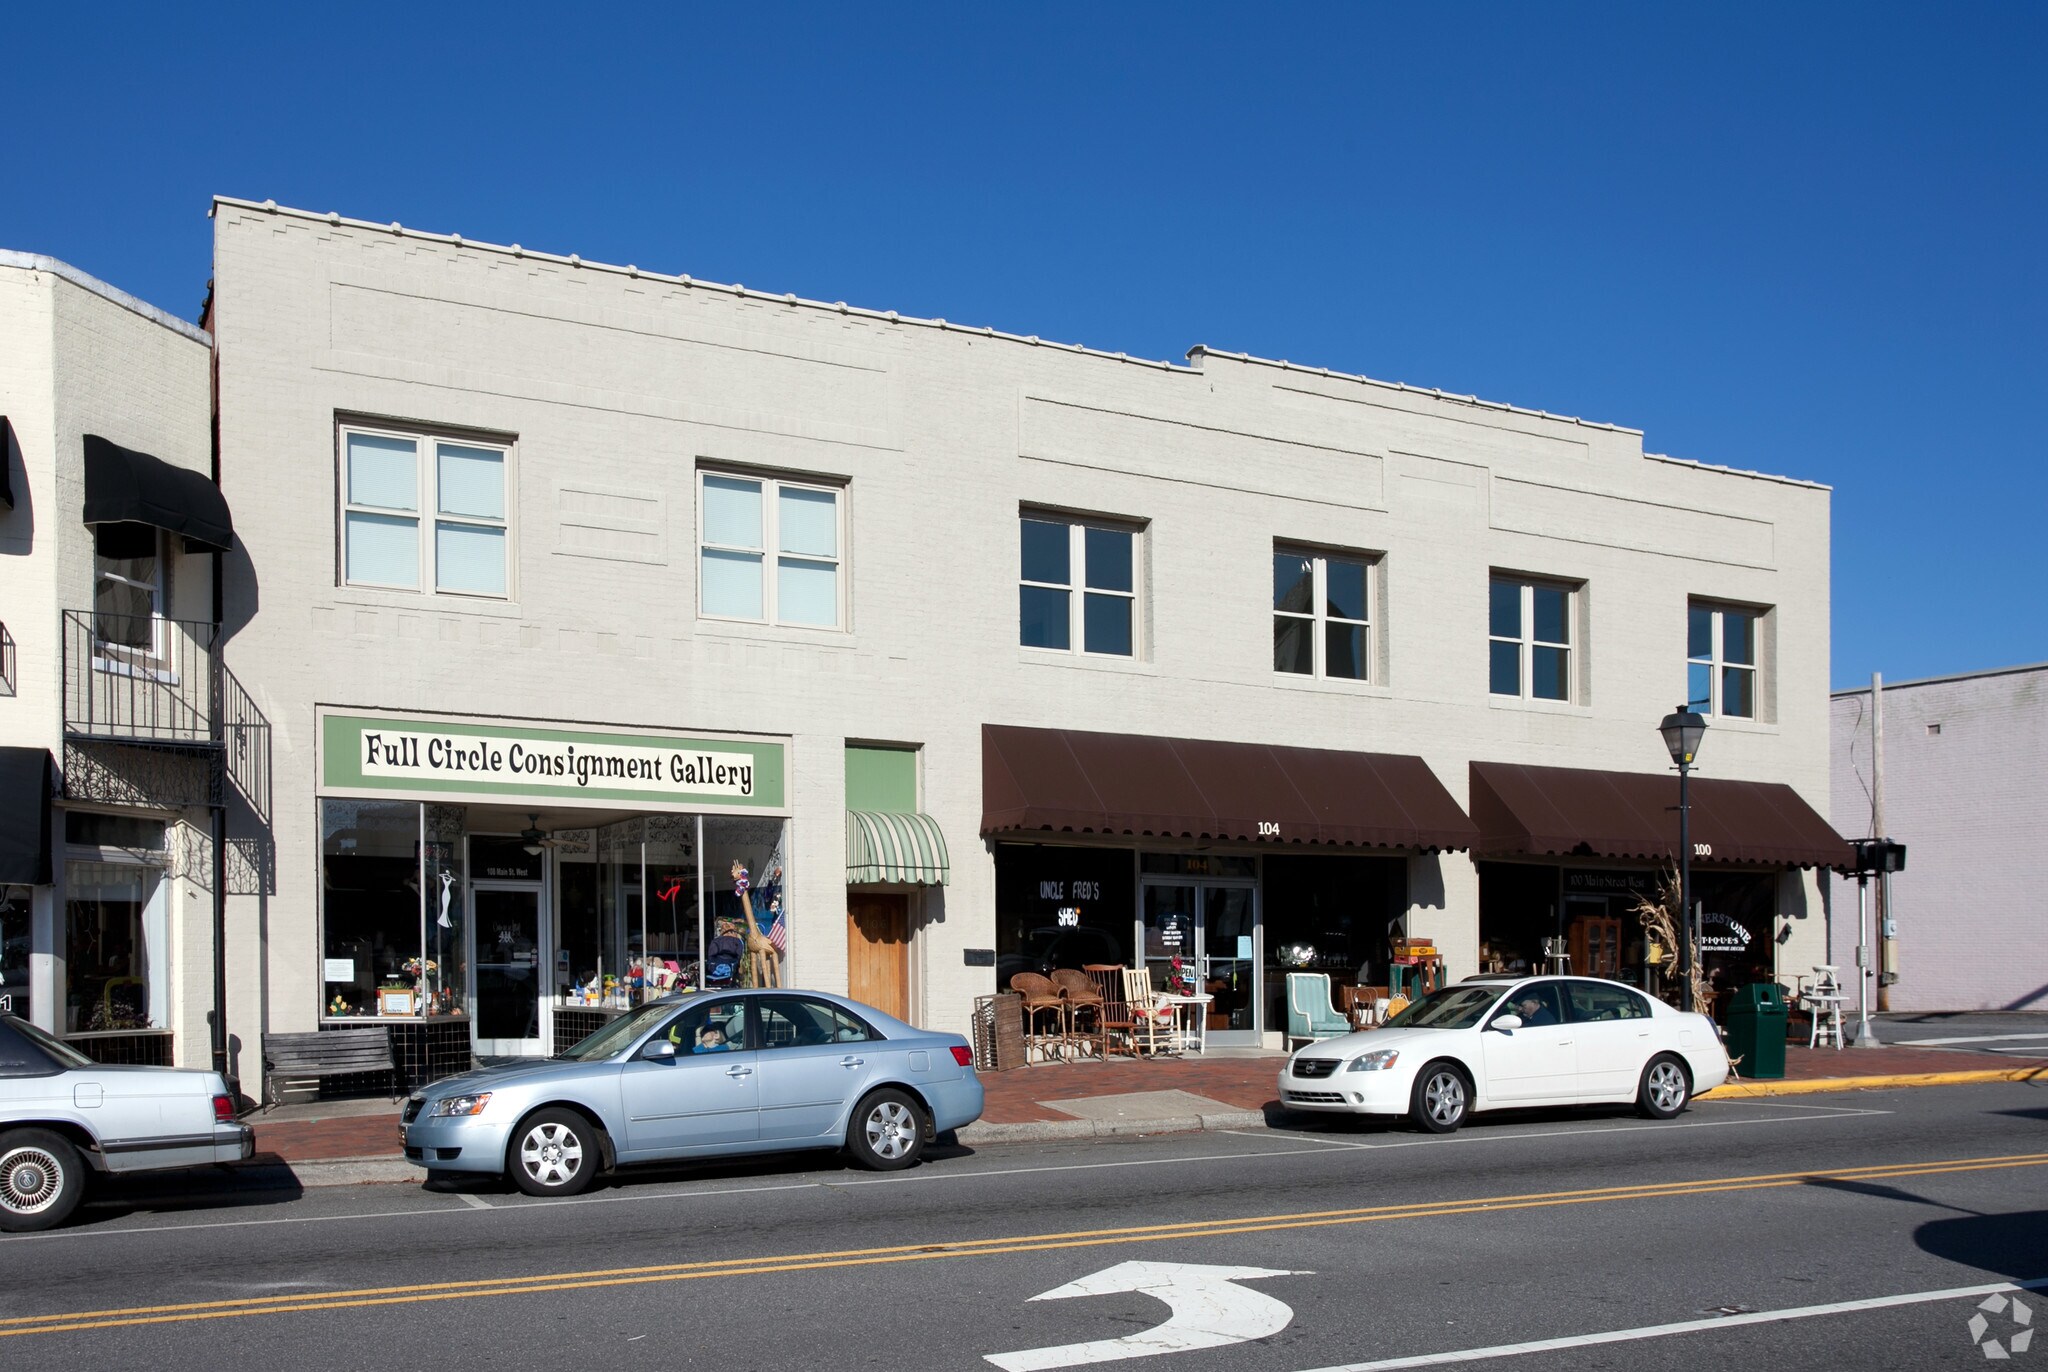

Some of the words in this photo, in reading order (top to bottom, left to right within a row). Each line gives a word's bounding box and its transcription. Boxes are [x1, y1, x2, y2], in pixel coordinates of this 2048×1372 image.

[365, 733, 421, 768] Full
[427, 738, 503, 772] Circle
[508, 742, 663, 787] Consignment
[669, 753, 753, 795] Gallery
[1257, 821, 1280, 836] 104
[1693, 843, 1712, 856] 100
[496, 867, 509, 876] Main
[516, 867, 529, 877] West
[1186, 858, 1209, 871] 104
[1570, 873, 1583, 886] 100
[1584, 873, 1604, 887] Main
[1604, 874, 1627, 888] Street
[1627, 874, 1645, 888] West
[1039, 879, 1065, 900] UNCLE
[1072, 880, 1100, 901] FRED'S
[1057, 906, 1079, 927] SHED
[1182, 967, 1194, 978] PEN
